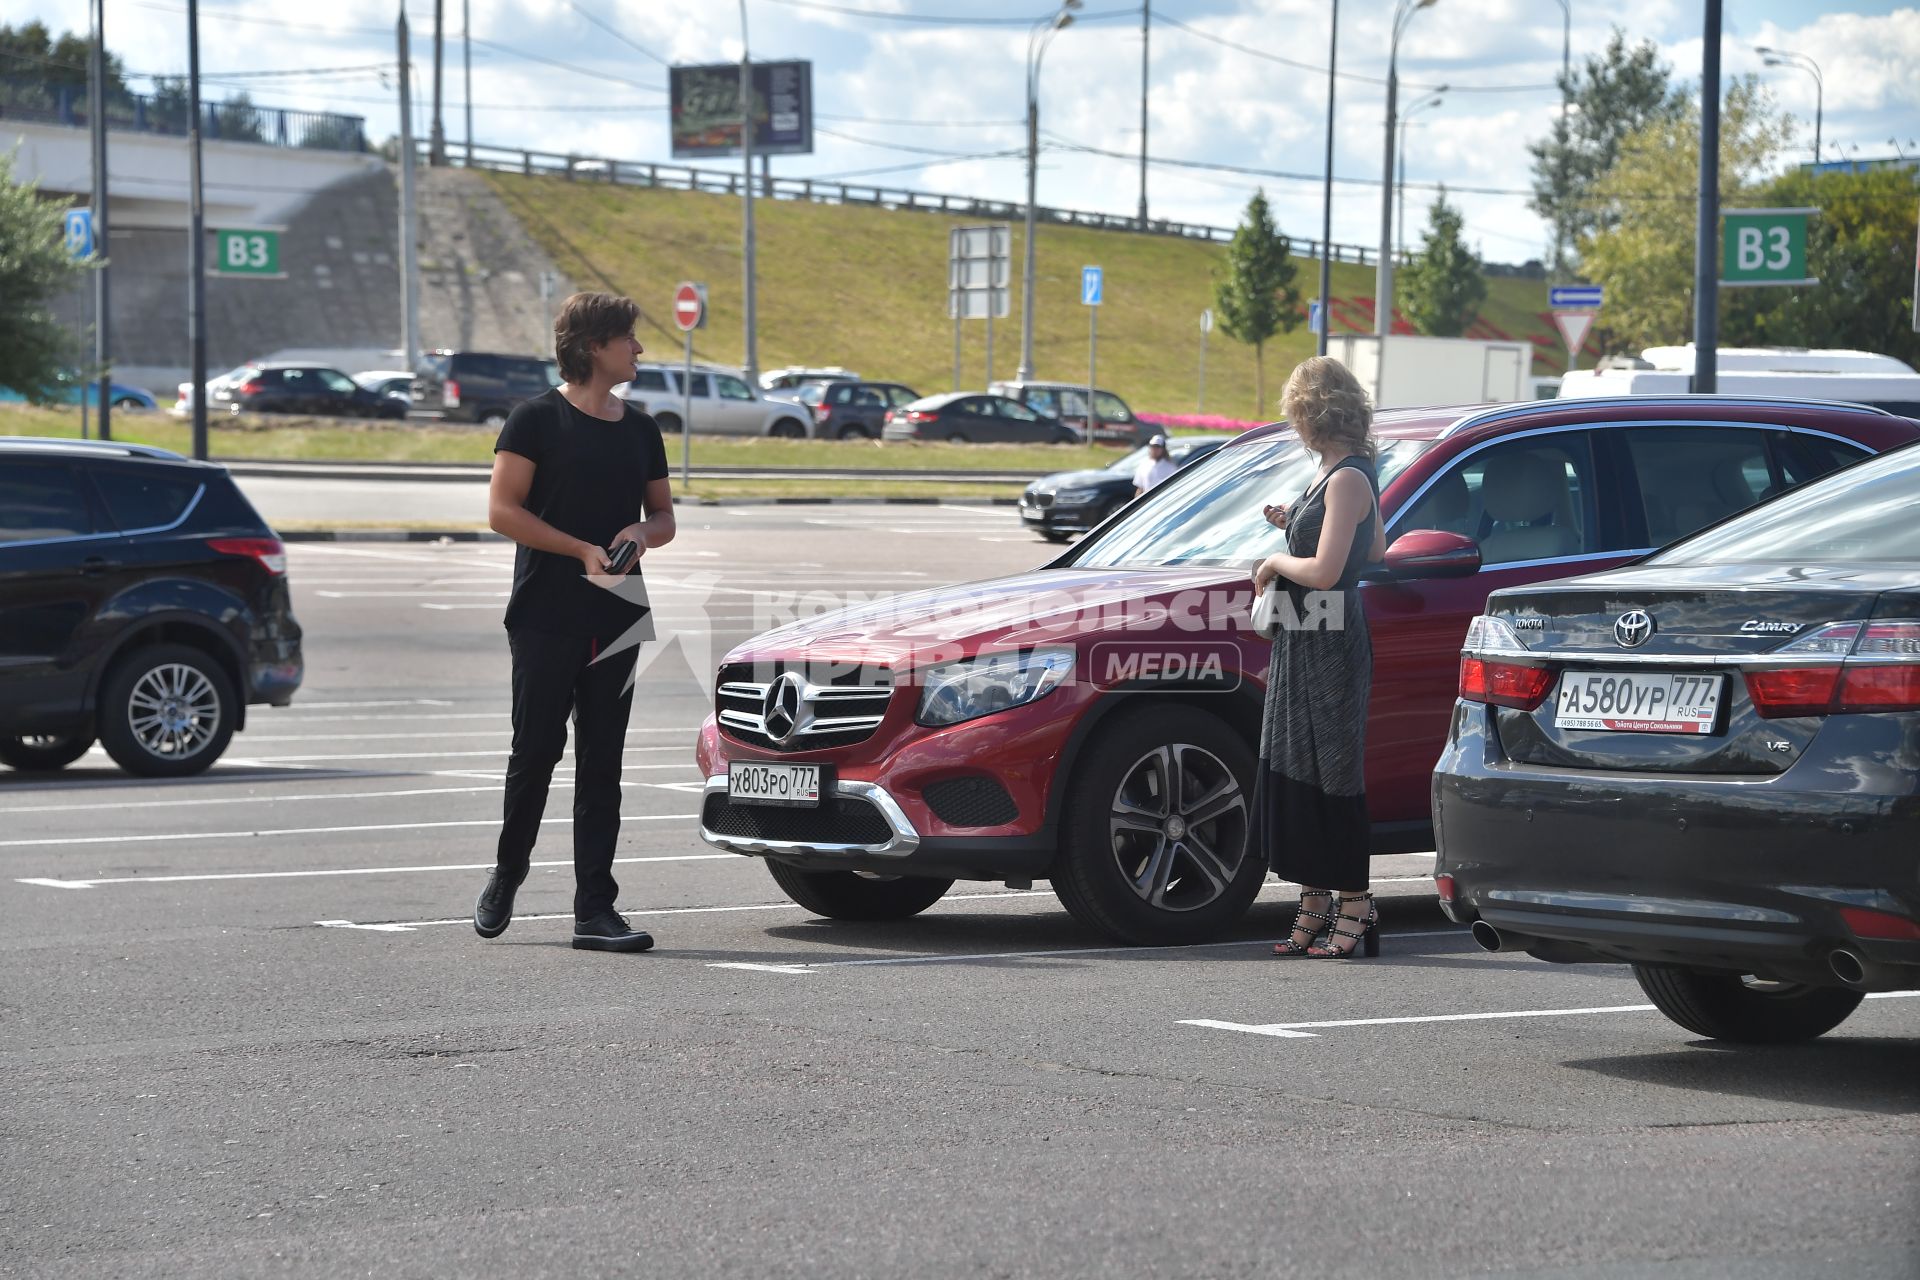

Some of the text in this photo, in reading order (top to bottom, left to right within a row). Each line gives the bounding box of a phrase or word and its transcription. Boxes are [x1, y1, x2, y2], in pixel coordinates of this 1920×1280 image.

[227, 236, 269, 268] B3
[1737, 226, 1792, 271] B3
[1515, 619, 1544, 629] TOYOTA
[1672, 677, 1715, 706] 777
[1677, 707, 1697, 717] RUS
[1560, 719, 1576, 727] (495)
[1614, 720, 1683, 731] Тойота Центр Сокольники
[791, 767, 815, 788] 777
[796, 788, 809, 797] RUS
